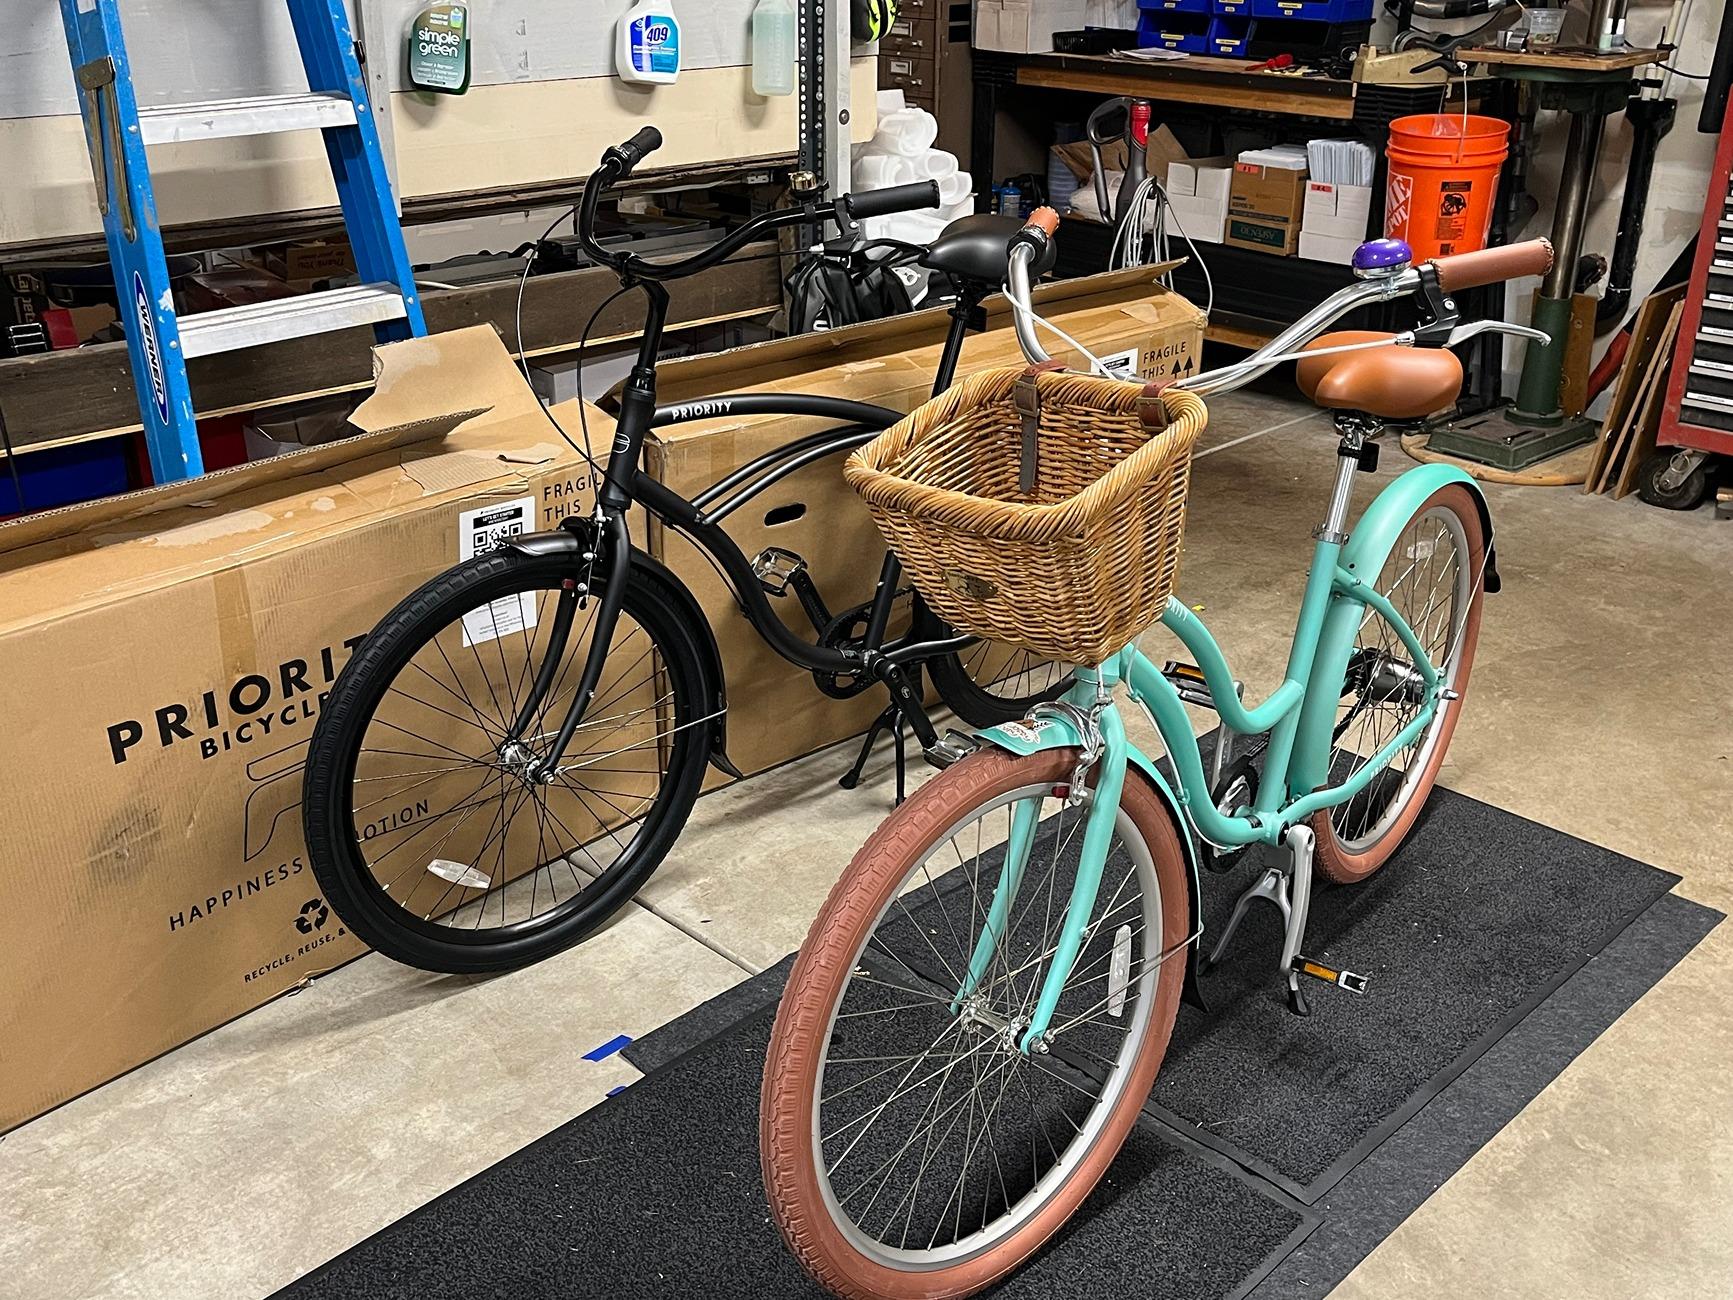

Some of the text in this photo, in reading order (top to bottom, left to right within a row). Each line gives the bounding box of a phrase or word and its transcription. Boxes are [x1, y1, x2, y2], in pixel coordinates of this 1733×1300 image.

[419, 27, 460, 46] simple
[647, 27, 668, 42] 409
[419, 42, 458, 57] green
[140, 305, 164, 394] WERNER
[1143, 341, 1186, 364] FRAGILE
[1142, 364, 1165, 379] THIS
[671, 401, 731, 420] PRIORITY
[544, 473, 601, 501] FRAGIL
[544, 499, 580, 522] THIS
[107, 633, 368, 765] PRIORIT
[169, 799, 429, 931] HAPPINESS OTION
[244, 954, 295, 983] RECYCLE,
[298, 933, 336, 956] REUSE,
